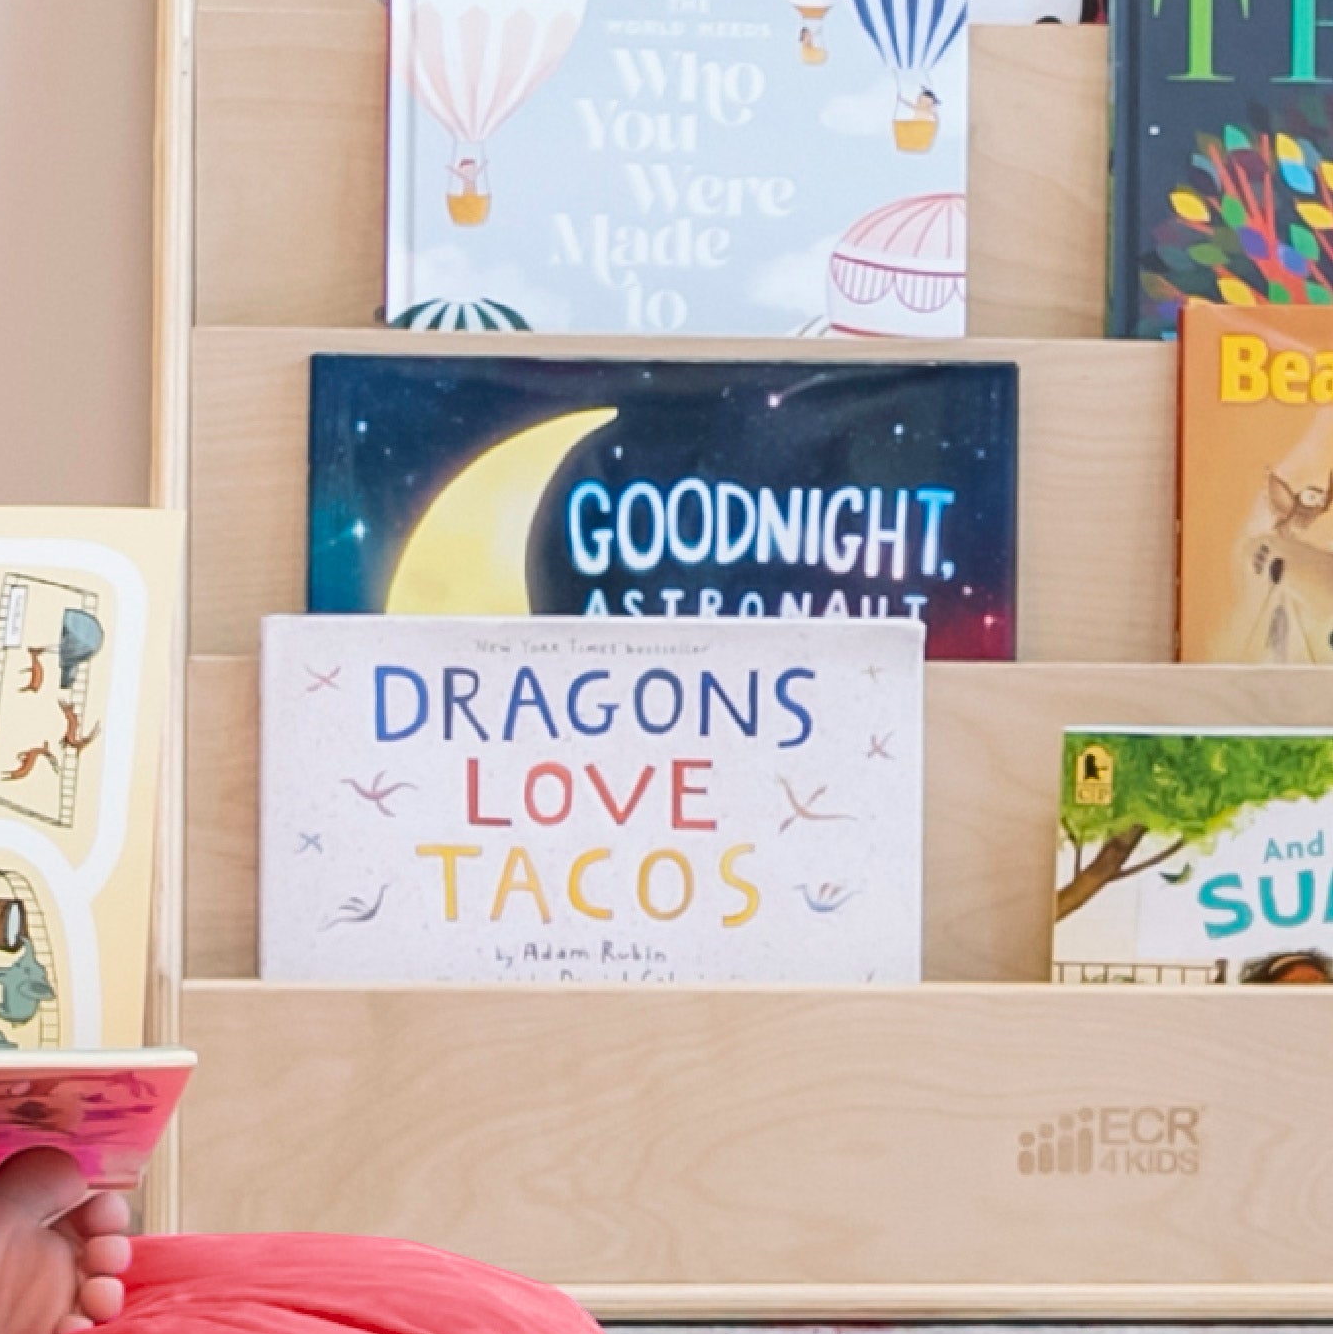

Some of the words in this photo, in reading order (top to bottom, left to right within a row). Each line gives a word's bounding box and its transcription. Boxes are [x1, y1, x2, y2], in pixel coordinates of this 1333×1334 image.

[611, 47, 766, 127] Who
[574, 97, 698, 152] You
[626, 163, 796, 216] Were
[547, 212, 731, 290] Made
[568, 477, 956, 581] GOODNIGHT,
[375, 666, 816, 748] DRAGONS
[467, 757, 717, 830] LOVE
[1264, 829, 1324, 863] And
[415, 844, 760, 927] TACOS
[1197, 869, 1333, 939] SU
[523, 942, 589, 961] Adam
[601, 940, 666, 963] Rubin
[1100, 1107, 1199, 1144] ECR
